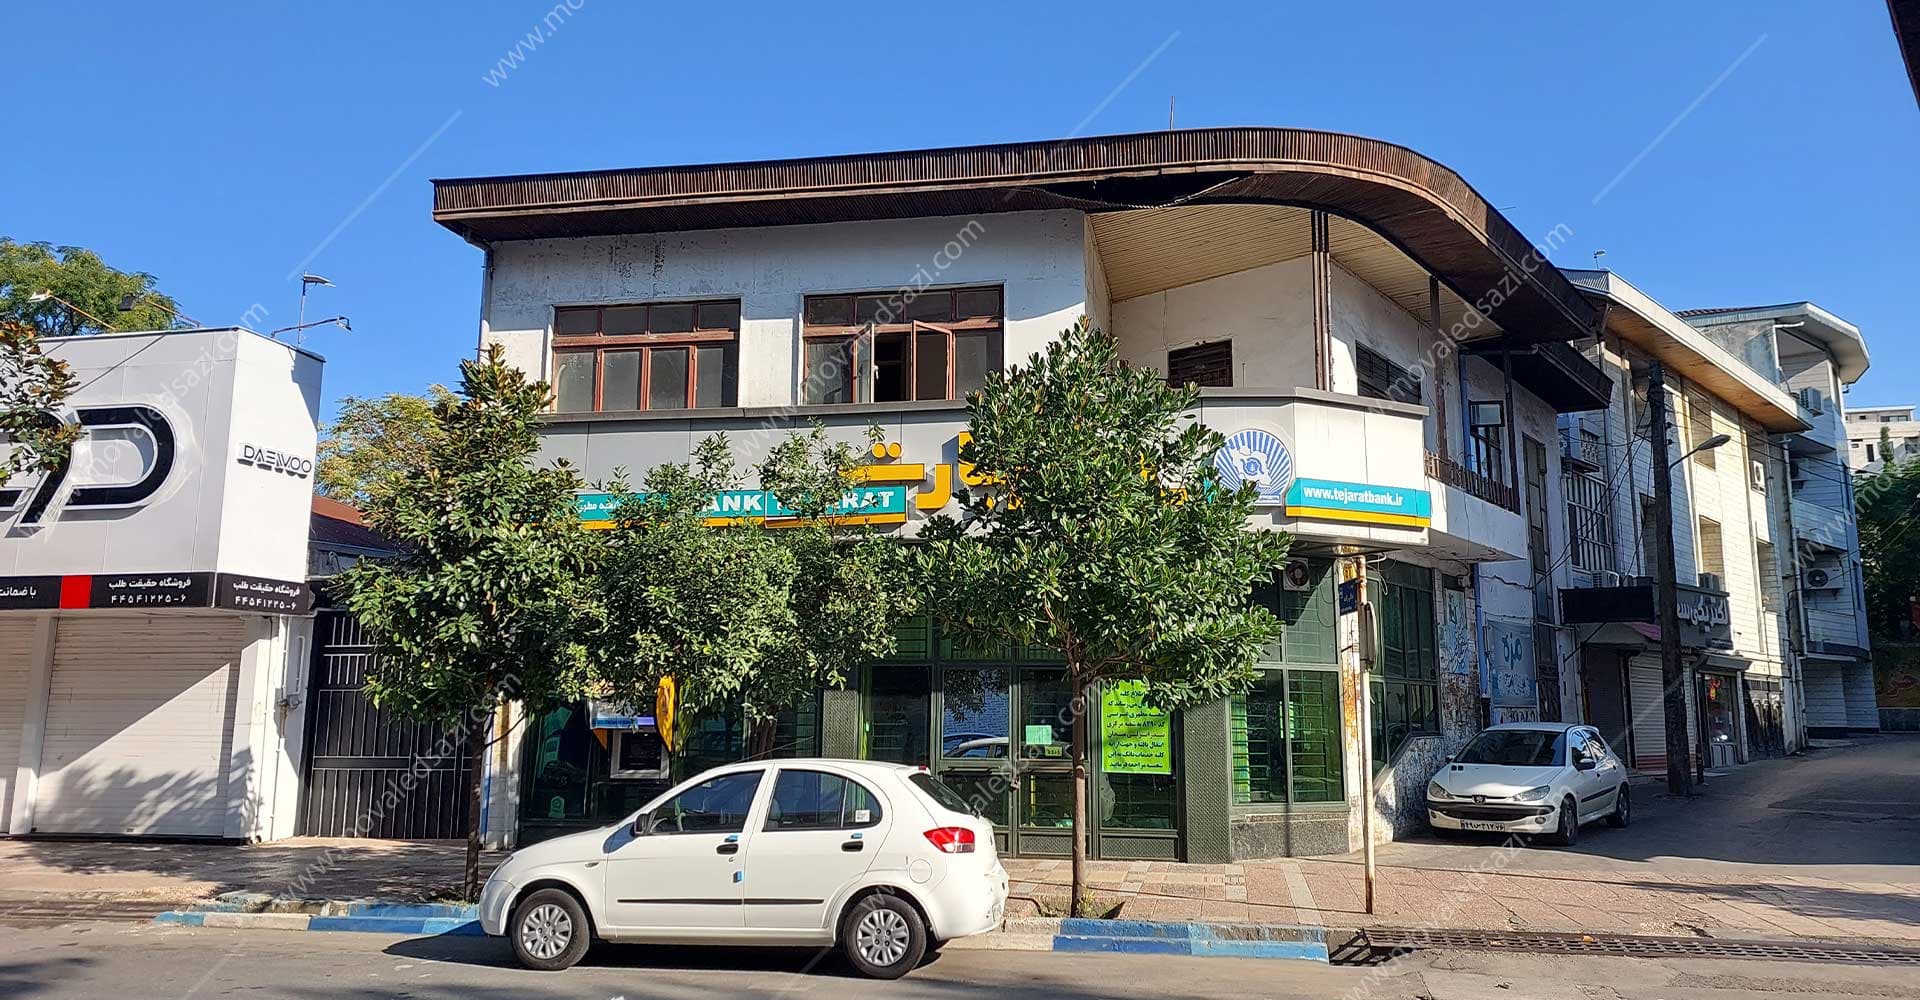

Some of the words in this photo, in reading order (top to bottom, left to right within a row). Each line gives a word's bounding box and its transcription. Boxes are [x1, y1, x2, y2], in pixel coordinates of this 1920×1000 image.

[244, 445, 312, 473] DAEWOO
[700, 493, 763, 512] ANK
[1303, 487, 1404, 506] www.tejaratbank.ir
[108, 580, 127, 590] طلب
[128, 579, 157, 590] حقیقت
[159, 577, 191, 589] فروشگاه
[233, 581, 249, 591] طلب
[250, 582, 274, 594] حقیقت
[29, 586, 37, 599] با
[275, 584, 300, 597] فروشگاه
